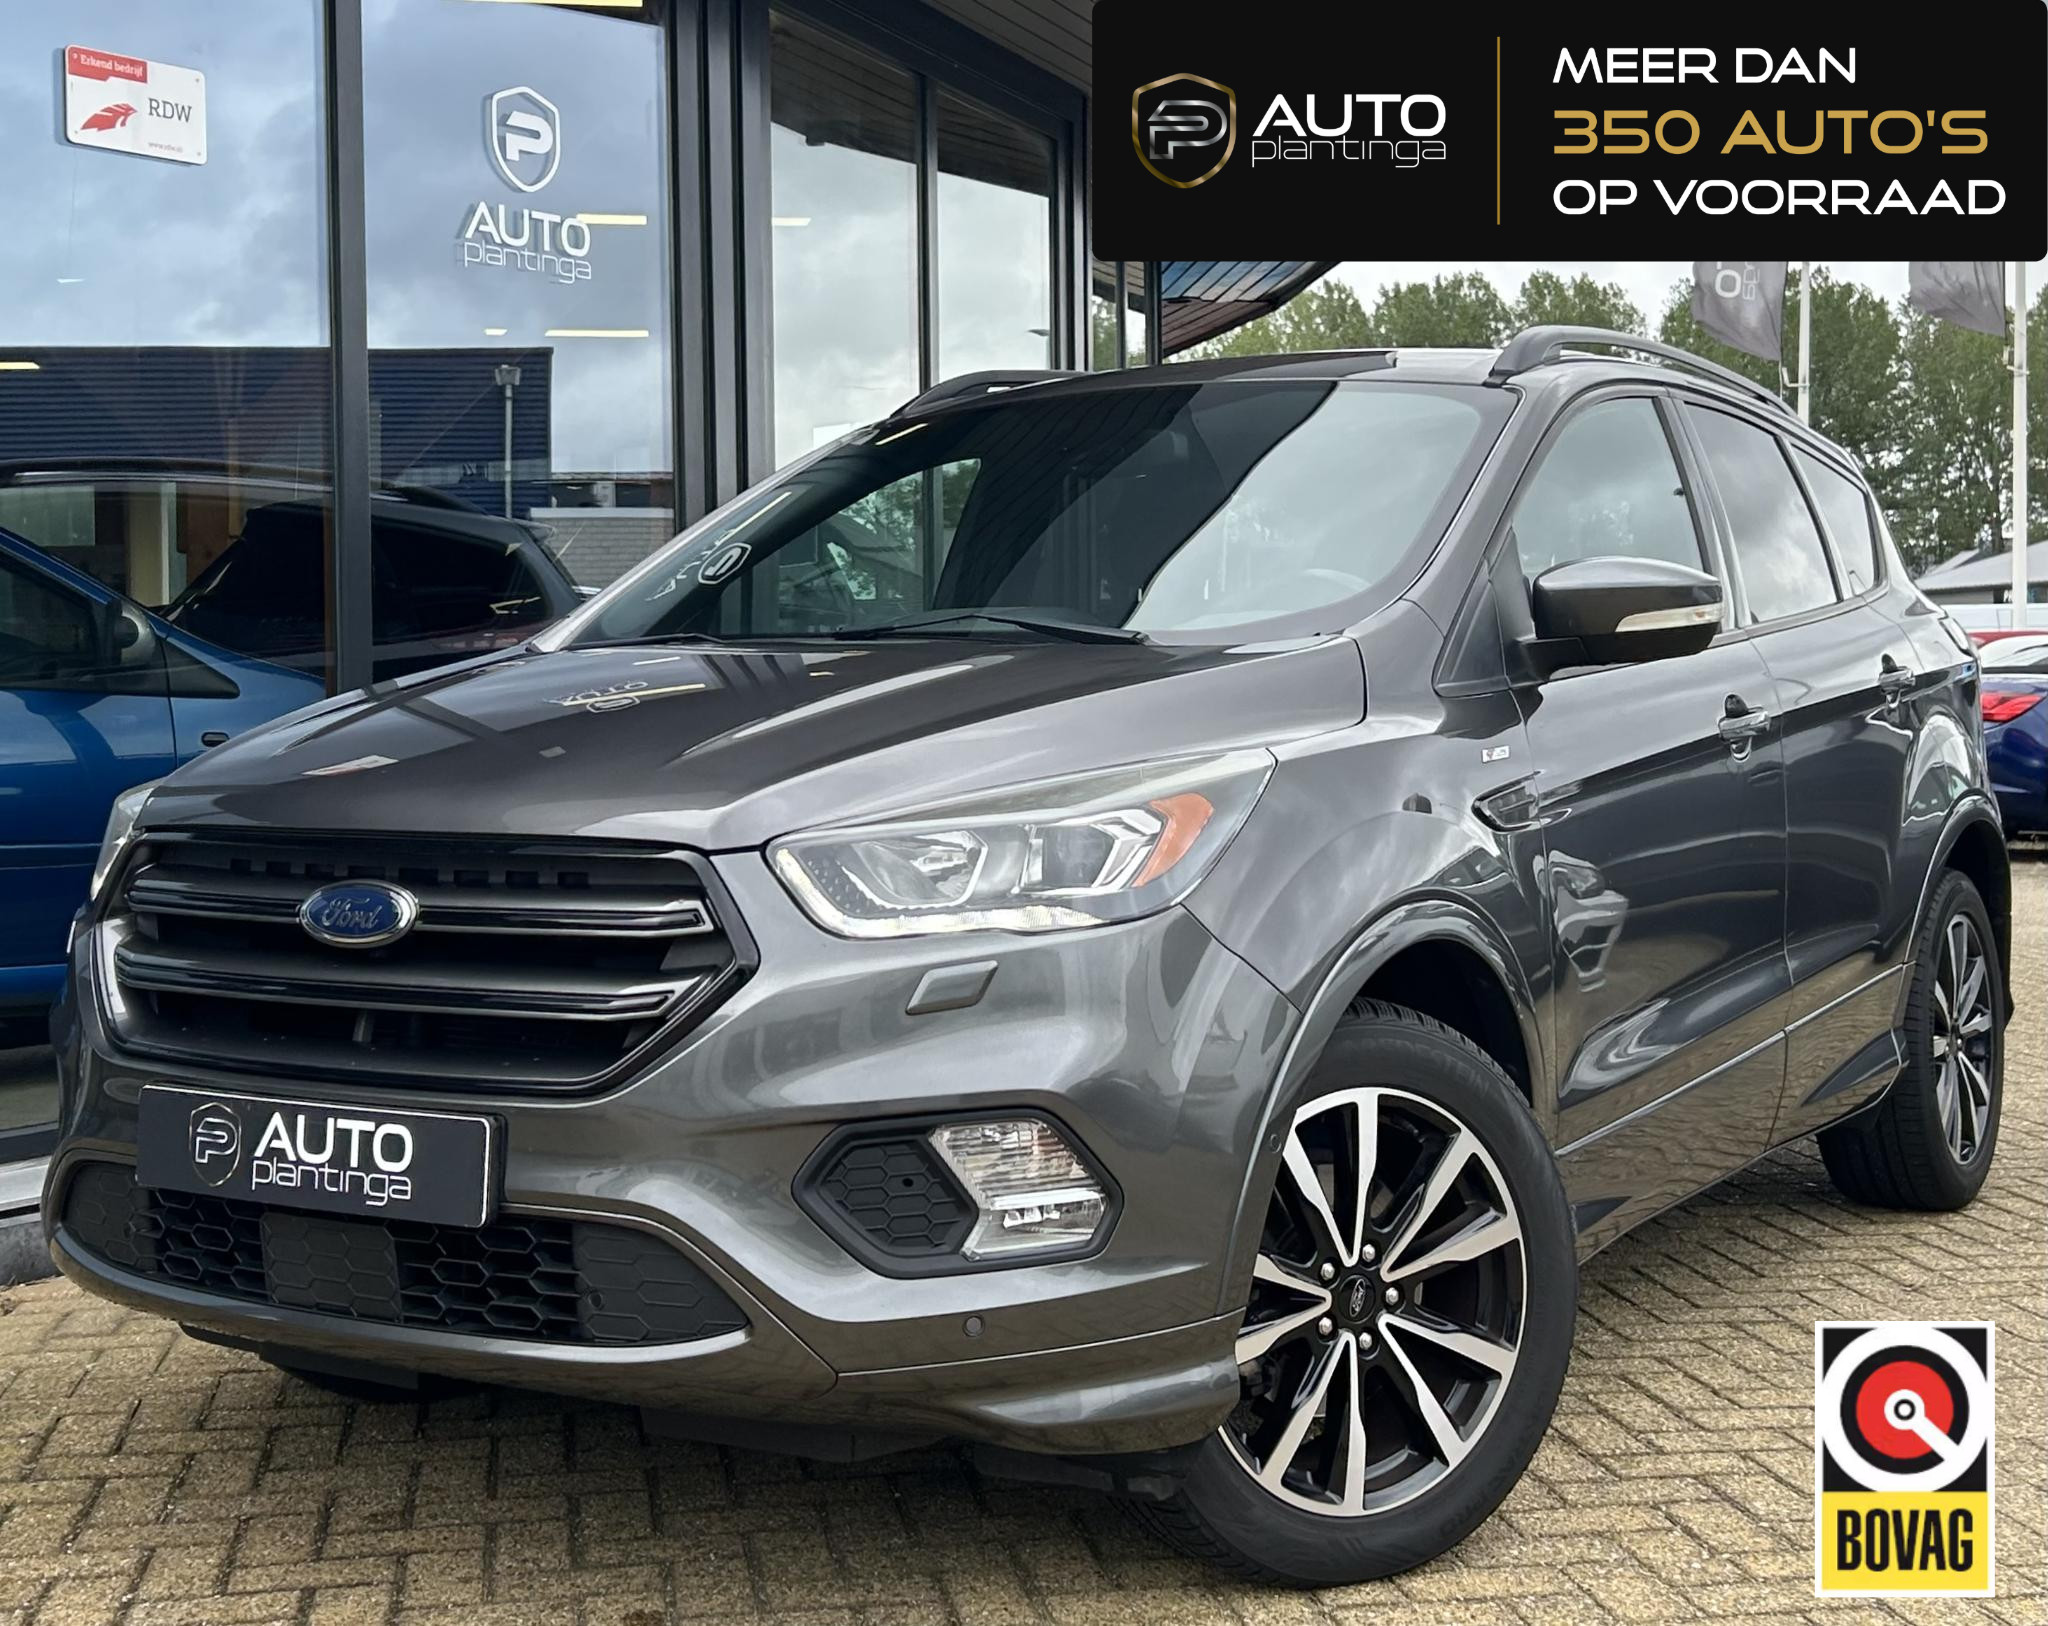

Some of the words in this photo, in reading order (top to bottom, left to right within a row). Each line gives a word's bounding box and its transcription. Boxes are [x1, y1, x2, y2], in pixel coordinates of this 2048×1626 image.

[114, 60, 144, 78] bedrijf
[148, 97, 192, 123] RDW
[465, 201, 591, 257] AUTO
[464, 240, 592, 284] plantinga
[321, 897, 384, 929] Ford
[253, 1111, 413, 1173] AUTO
[251, 1156, 412, 1207] plantinga
